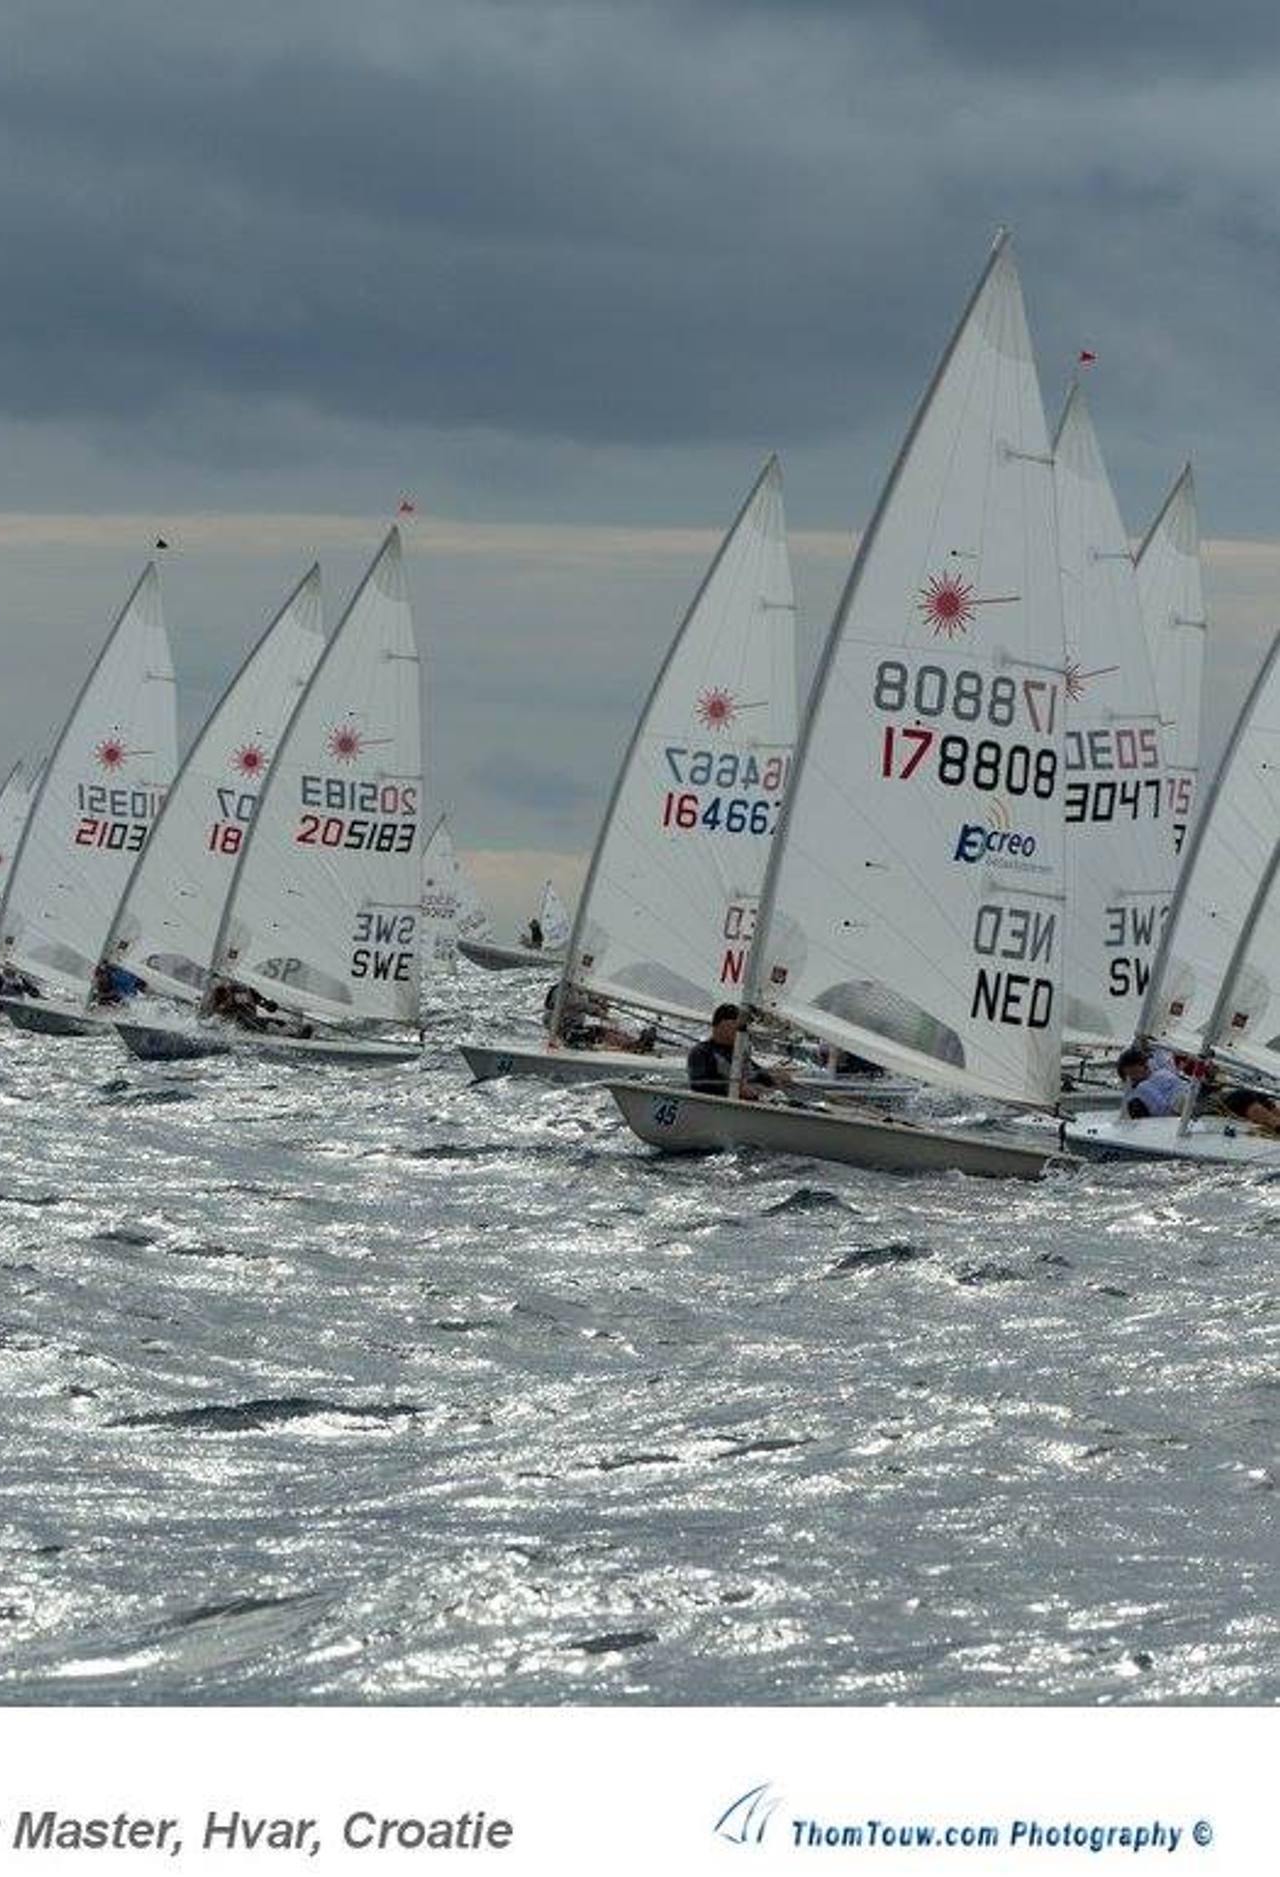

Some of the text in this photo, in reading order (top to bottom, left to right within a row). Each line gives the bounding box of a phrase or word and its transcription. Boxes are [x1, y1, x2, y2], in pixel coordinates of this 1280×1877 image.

[883, 726, 1058, 799] 178808
[75, 818, 147, 851] 2103
[210, 823, 242, 855] 18
[298, 815, 417, 852] 205183
[351, 949, 414, 981] SWE
[971, 967, 1054, 1029] NED
